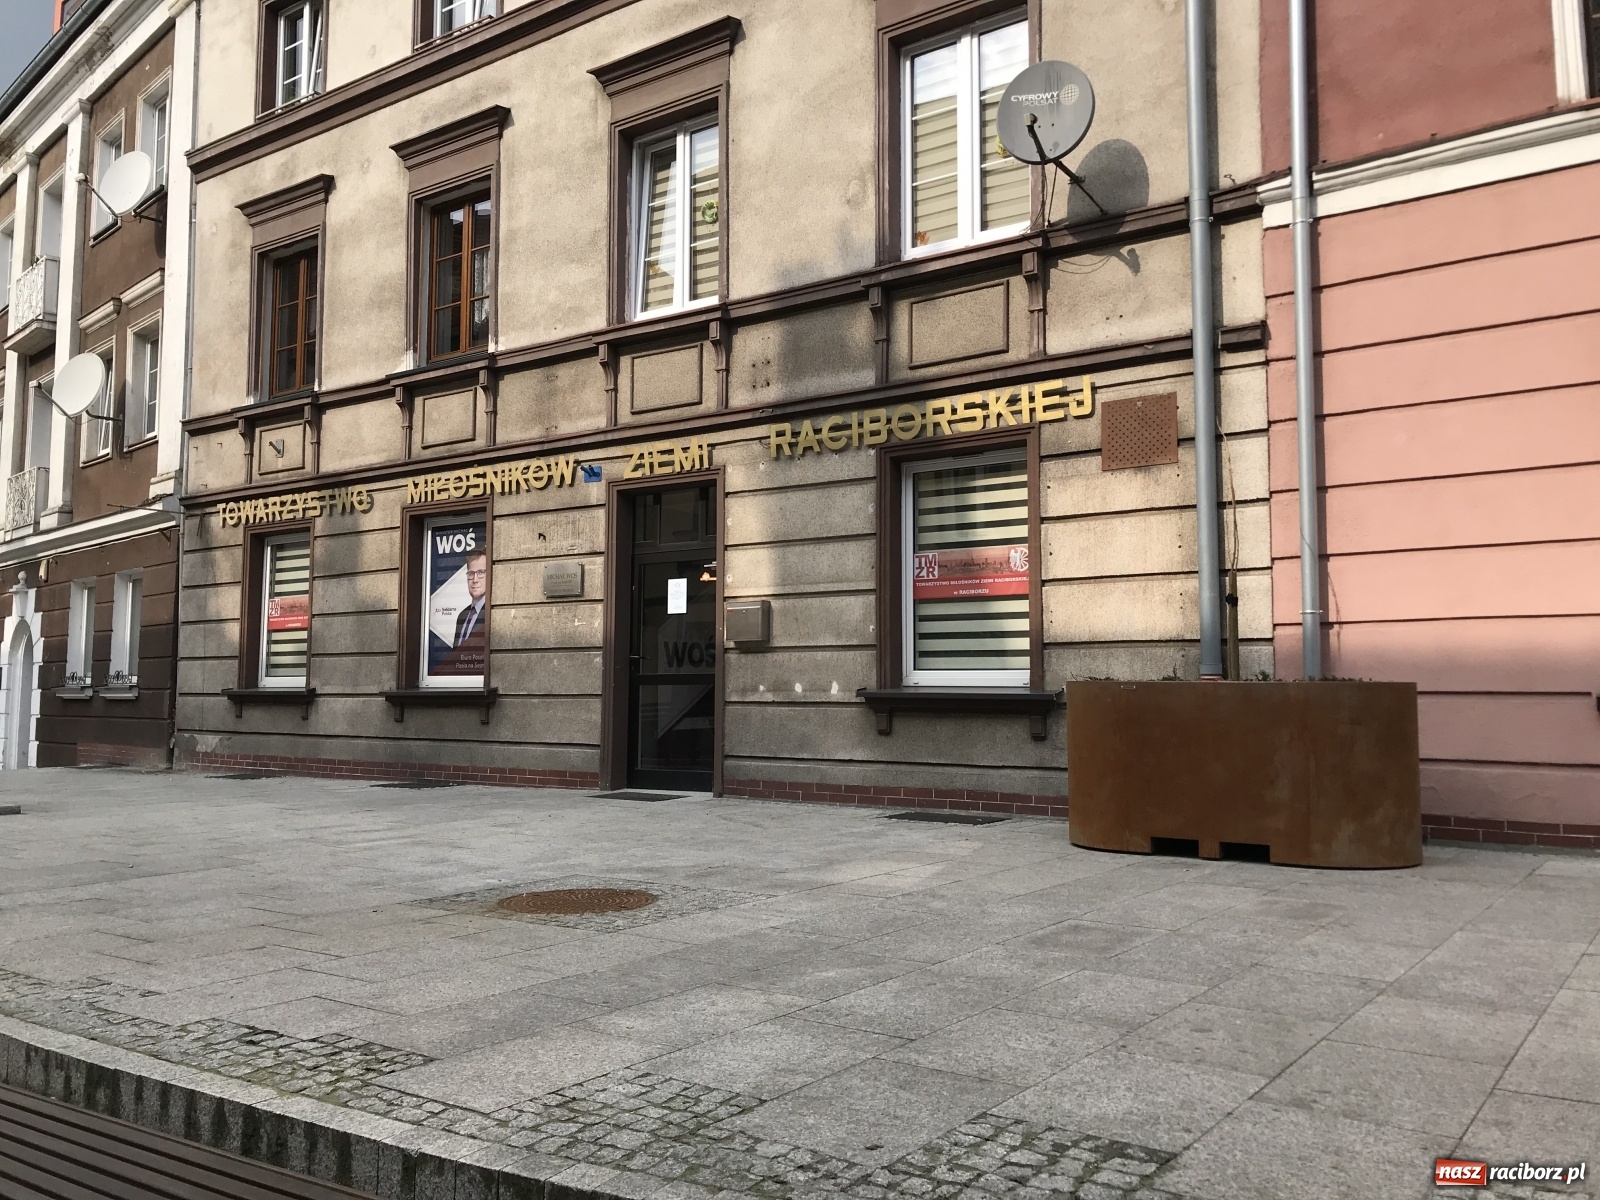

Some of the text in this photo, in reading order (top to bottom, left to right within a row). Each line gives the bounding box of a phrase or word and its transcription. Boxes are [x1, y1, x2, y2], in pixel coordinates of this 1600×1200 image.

[1011, 91, 1058, 102] CYFROWY
[1023, 97, 1058, 107] POLSAT
[217, 485, 368, 526] TOWARZYSTWO
[623, 436, 709, 479] ZIEMI
[770, 375, 1092, 458] RACIBORSKIEJ
[436, 528, 476, 554] WOŚ
